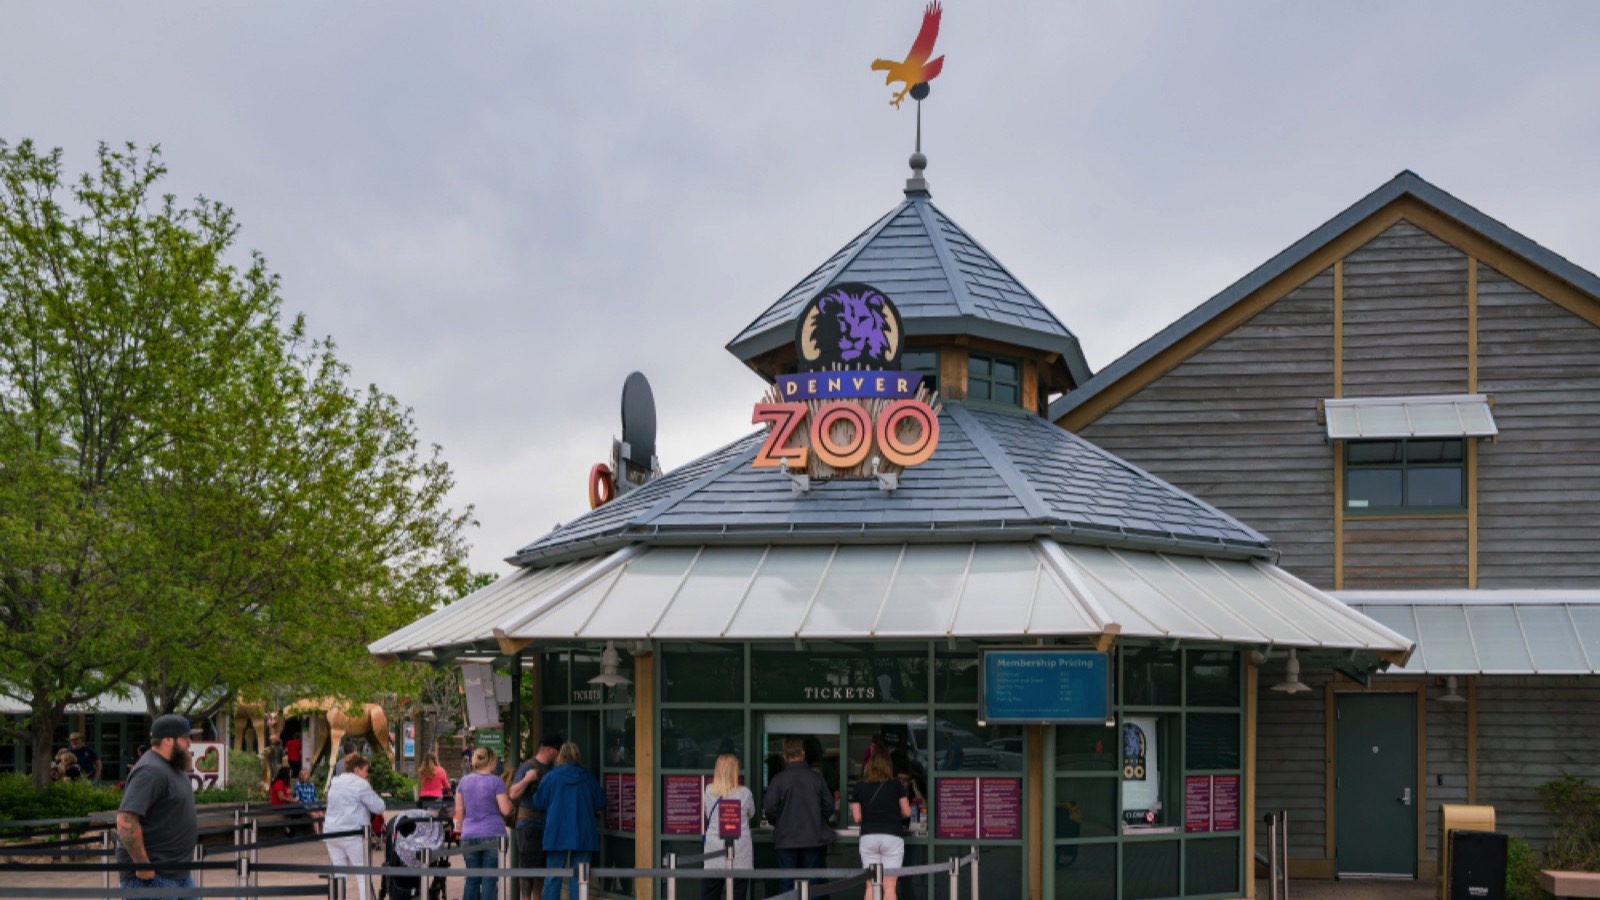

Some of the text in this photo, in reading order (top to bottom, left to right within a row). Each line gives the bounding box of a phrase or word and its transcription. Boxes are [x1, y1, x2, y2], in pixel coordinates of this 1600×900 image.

[786, 377, 909, 395] DENVER
[751, 400, 940, 468] ZOO
[996, 658, 1094, 669] Membership Pricing
[573, 689, 601, 702] TICKETS
[804, 687, 876, 700] TICKETS
